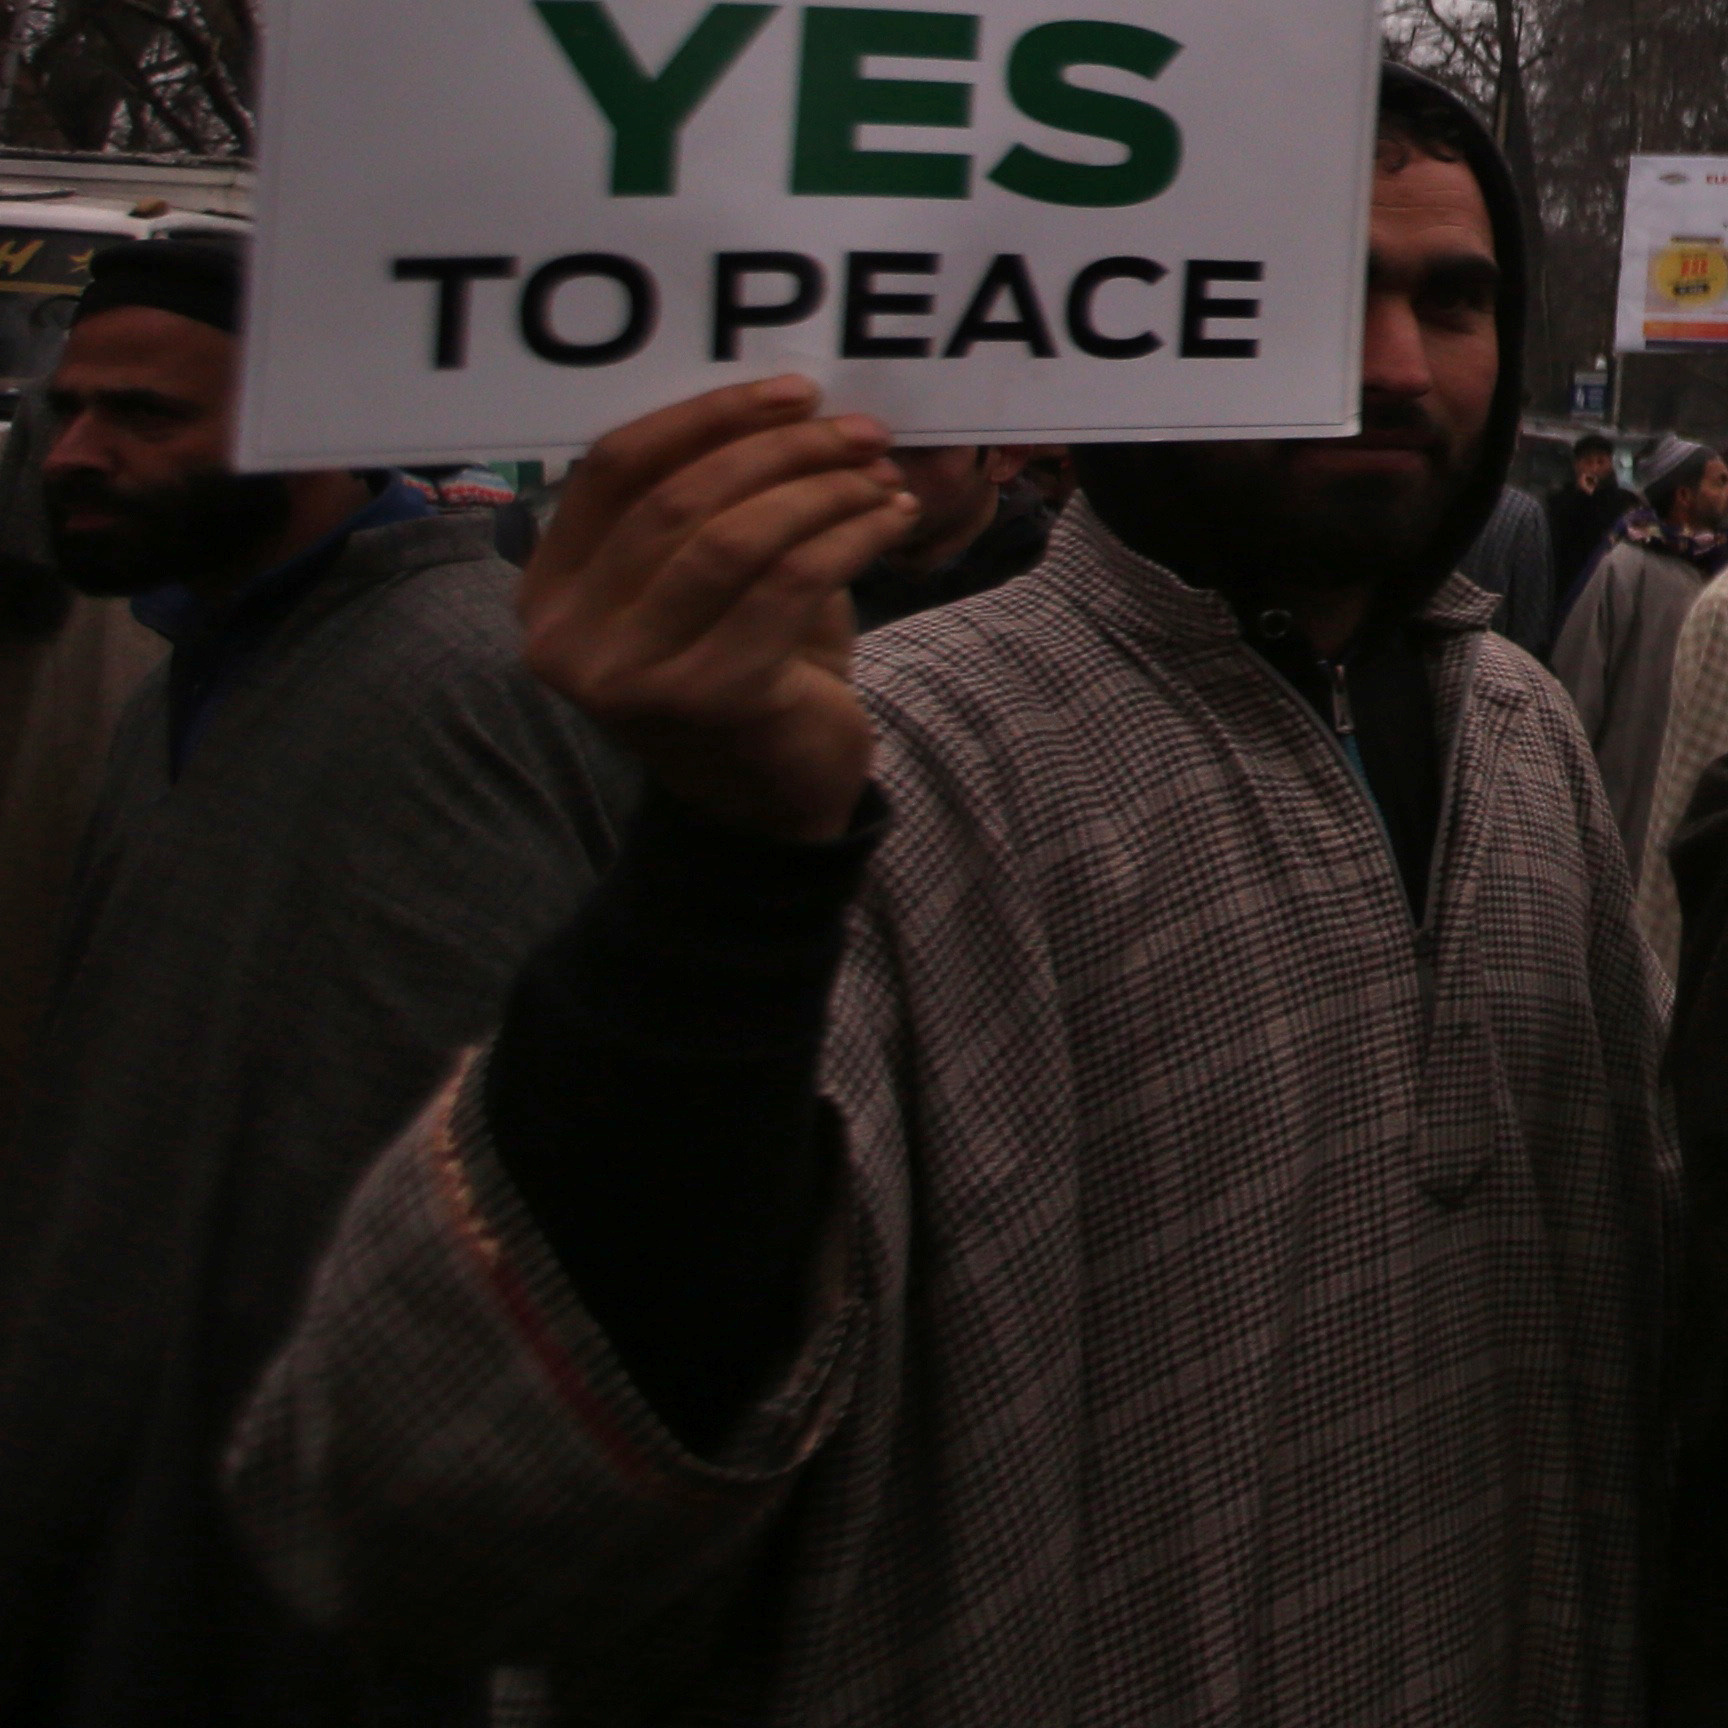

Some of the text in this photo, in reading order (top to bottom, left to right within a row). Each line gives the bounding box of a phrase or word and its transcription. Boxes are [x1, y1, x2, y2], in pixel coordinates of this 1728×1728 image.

[532, 0, 1184, 208] YES
[390, 249, 1266, 372] TO PEACE
